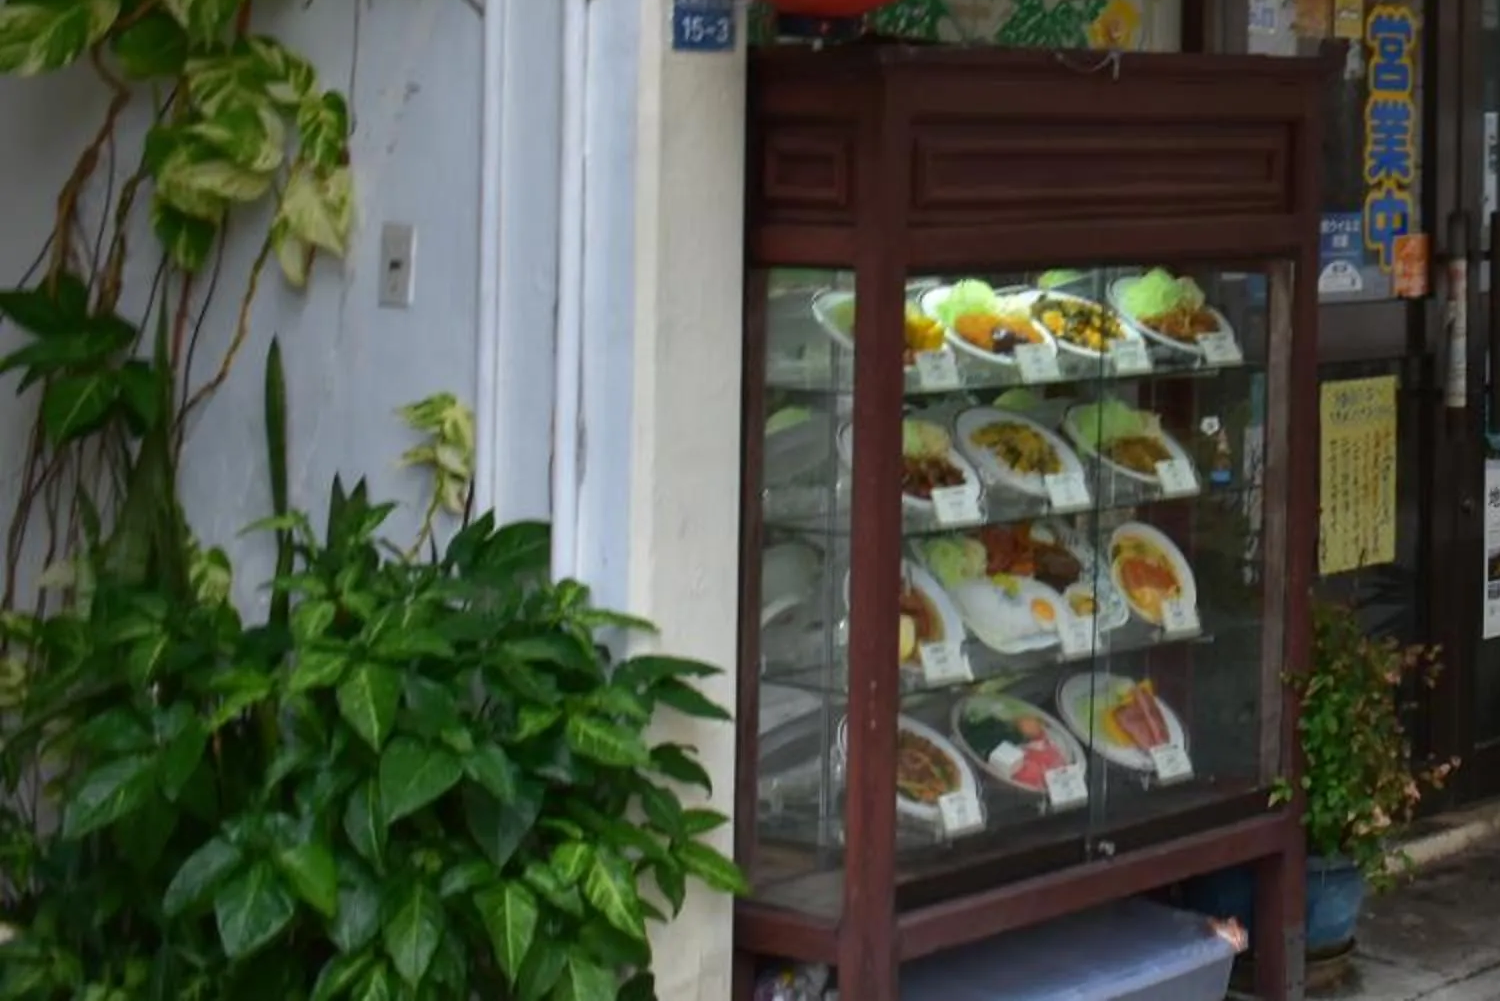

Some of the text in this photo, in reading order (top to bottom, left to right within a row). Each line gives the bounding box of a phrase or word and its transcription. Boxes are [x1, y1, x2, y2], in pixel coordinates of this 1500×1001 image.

[681, 15, 730, 43] 15-3
[1365, 6, 1415, 272] 営業中
